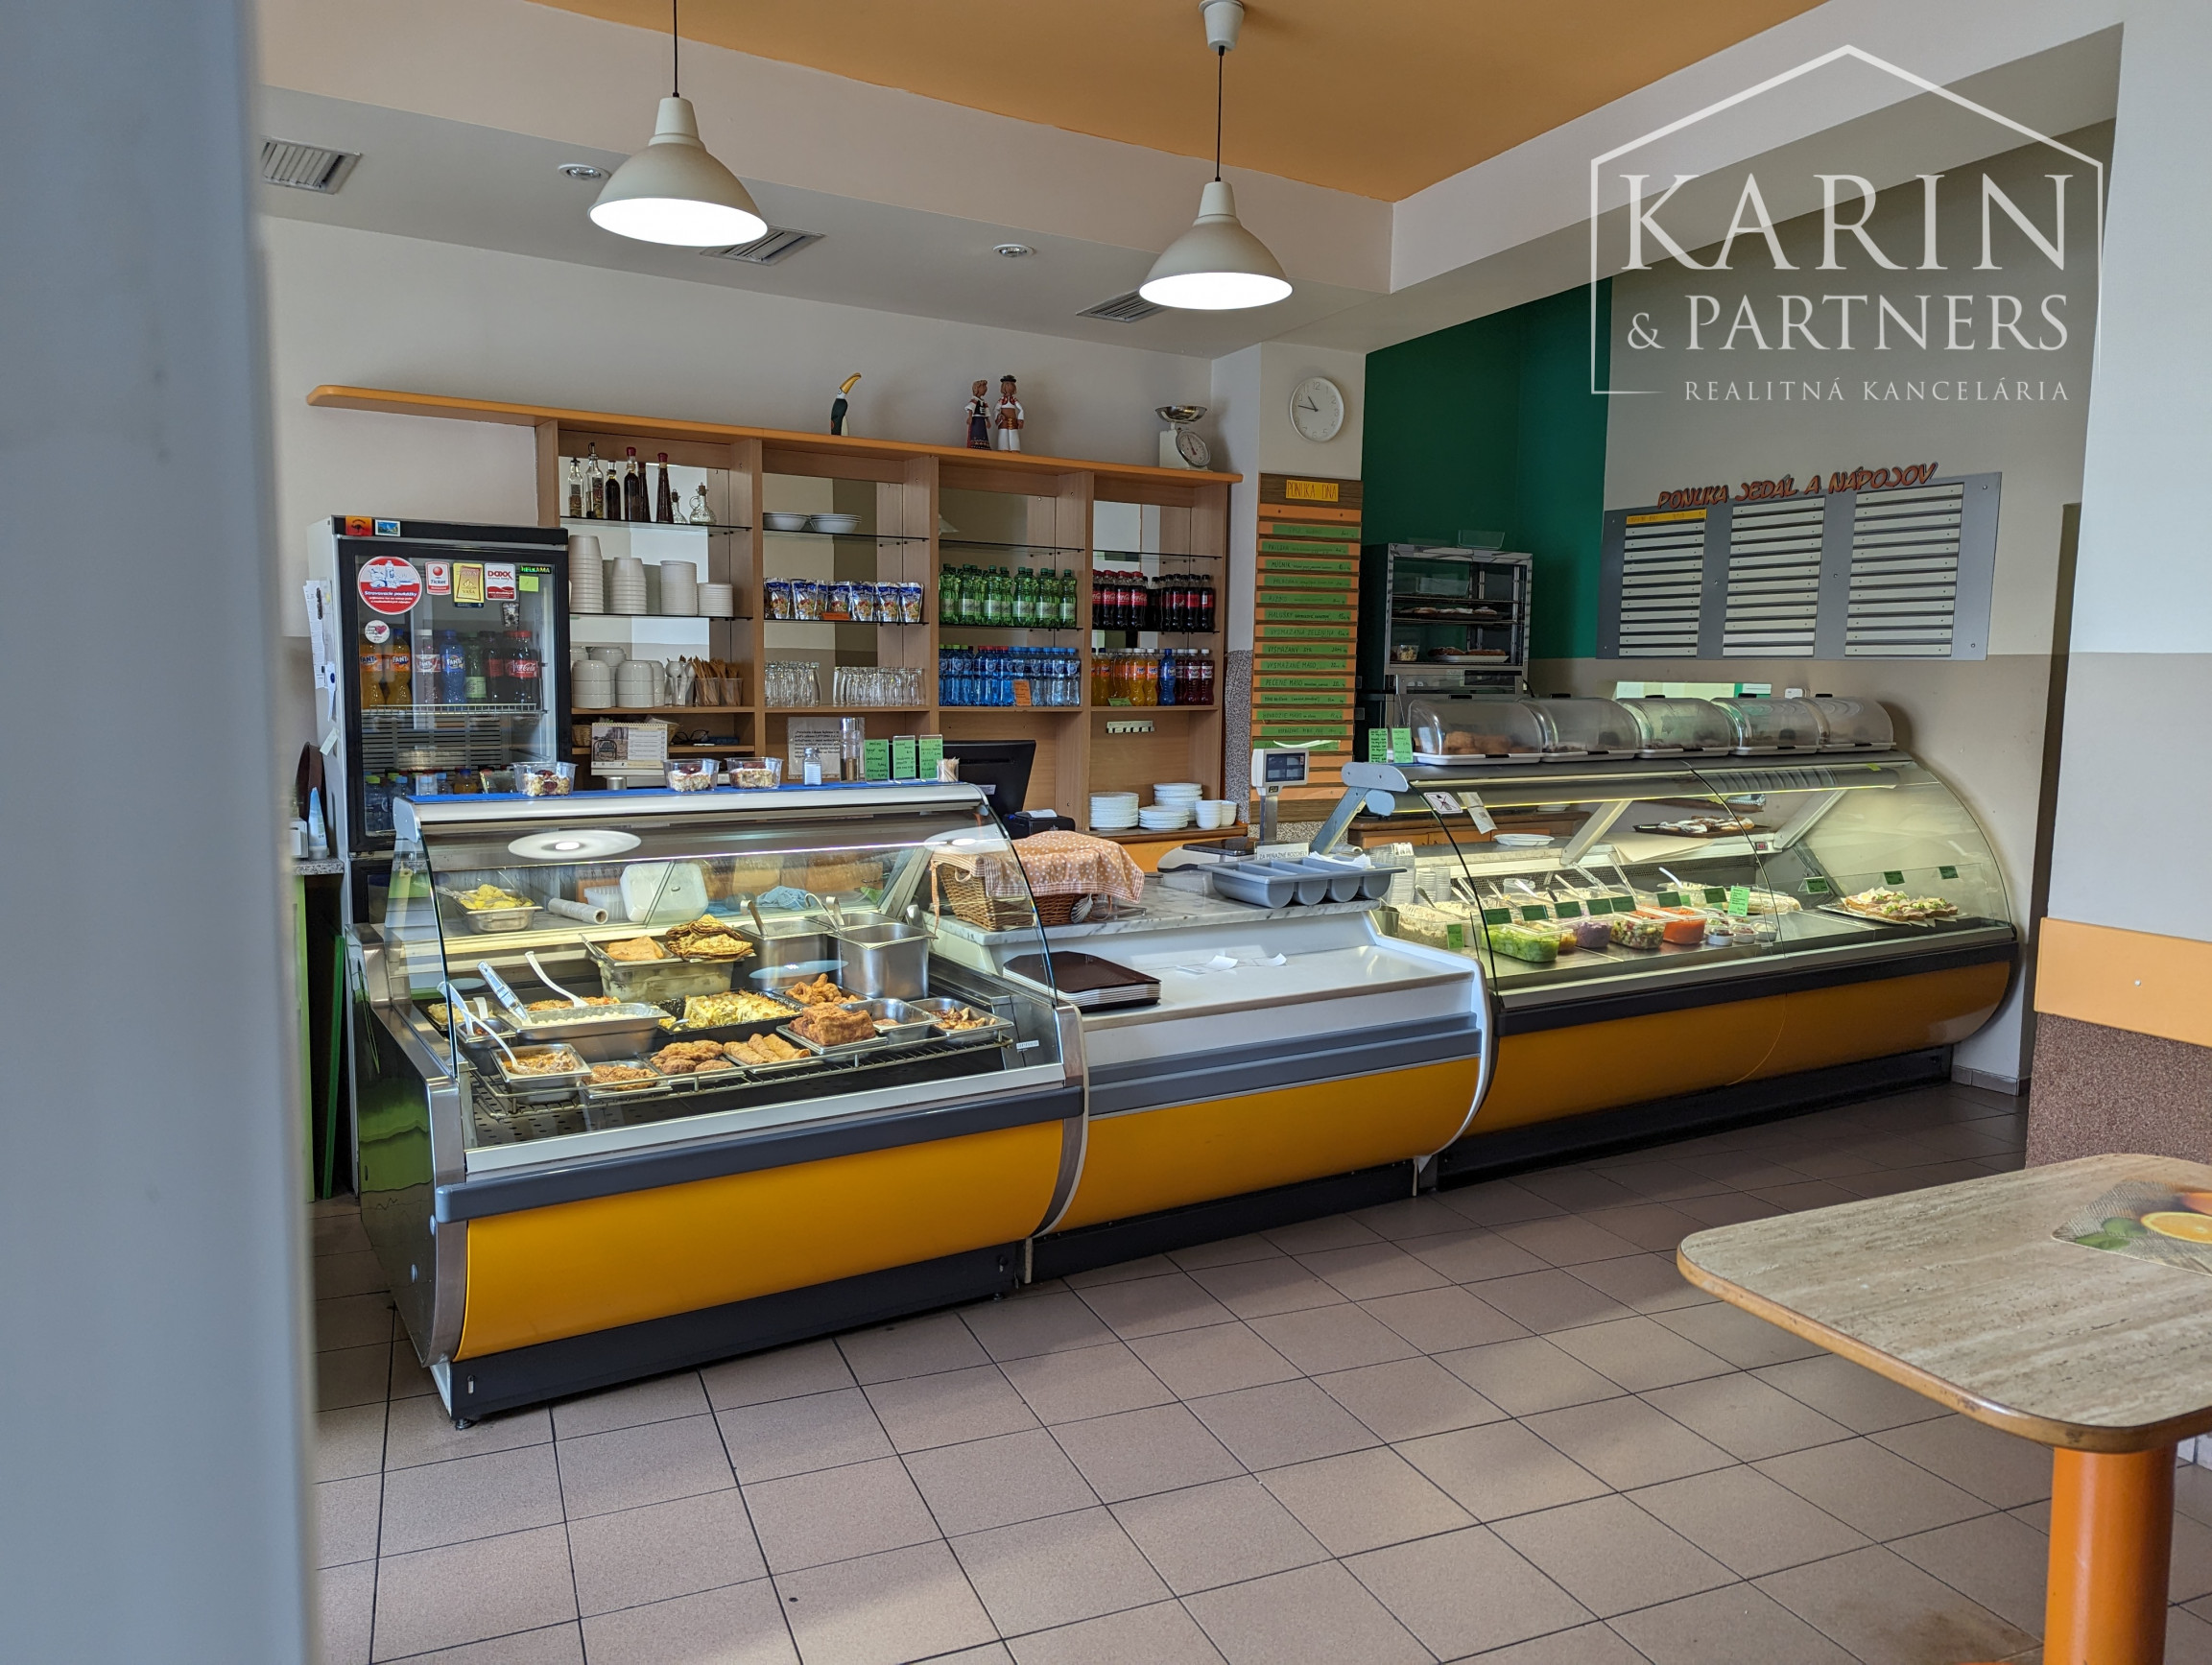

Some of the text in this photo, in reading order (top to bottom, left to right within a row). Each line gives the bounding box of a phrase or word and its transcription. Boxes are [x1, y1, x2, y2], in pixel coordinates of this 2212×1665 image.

[1286, 481, 1337, 500] PONUKA DŇA
[1657, 462, 1938, 510] PONUKA JEDÁL A NÁPOJOV
[488, 570, 513, 580] DOXX
